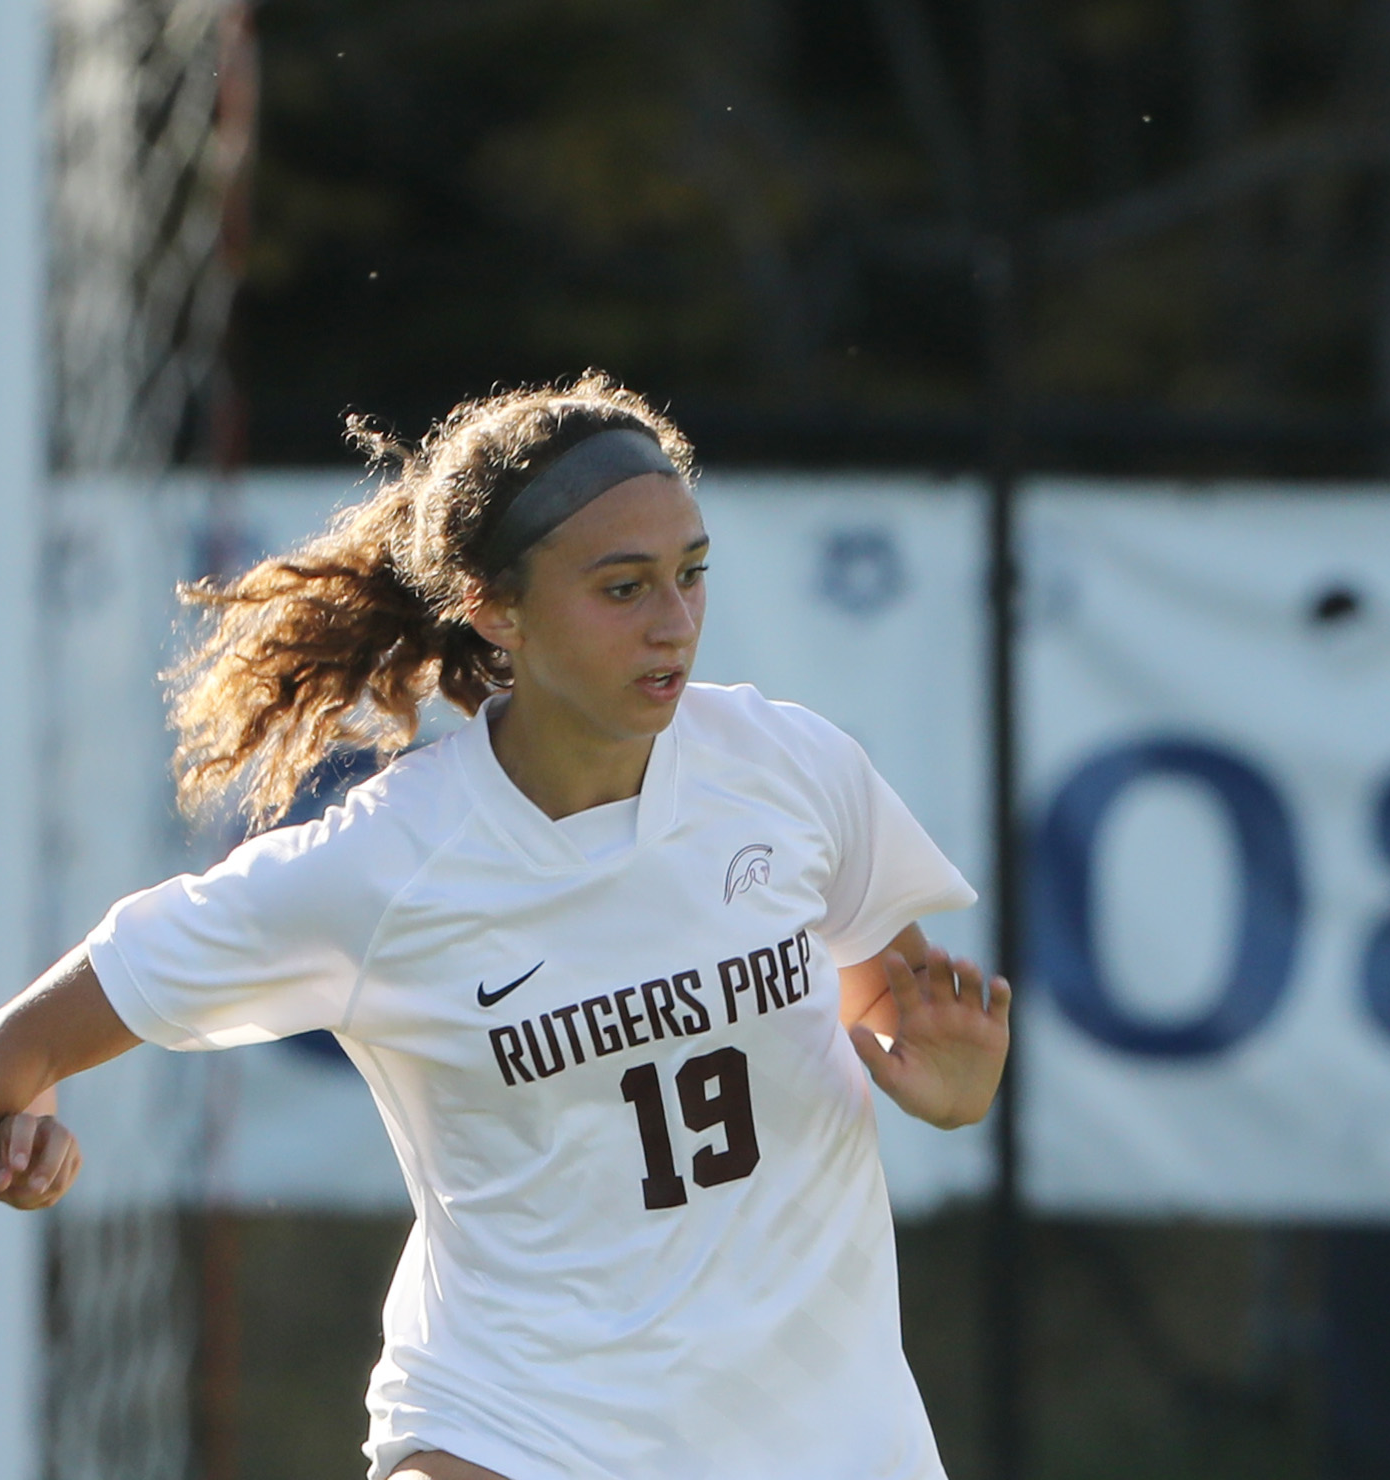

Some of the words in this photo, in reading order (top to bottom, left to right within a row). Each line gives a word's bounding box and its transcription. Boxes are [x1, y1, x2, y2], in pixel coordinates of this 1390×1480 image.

[488, 968, 712, 1087] RUTGERS
[716, 928, 810, 1025] PREP
[620, 1045, 761, 1211] 19
